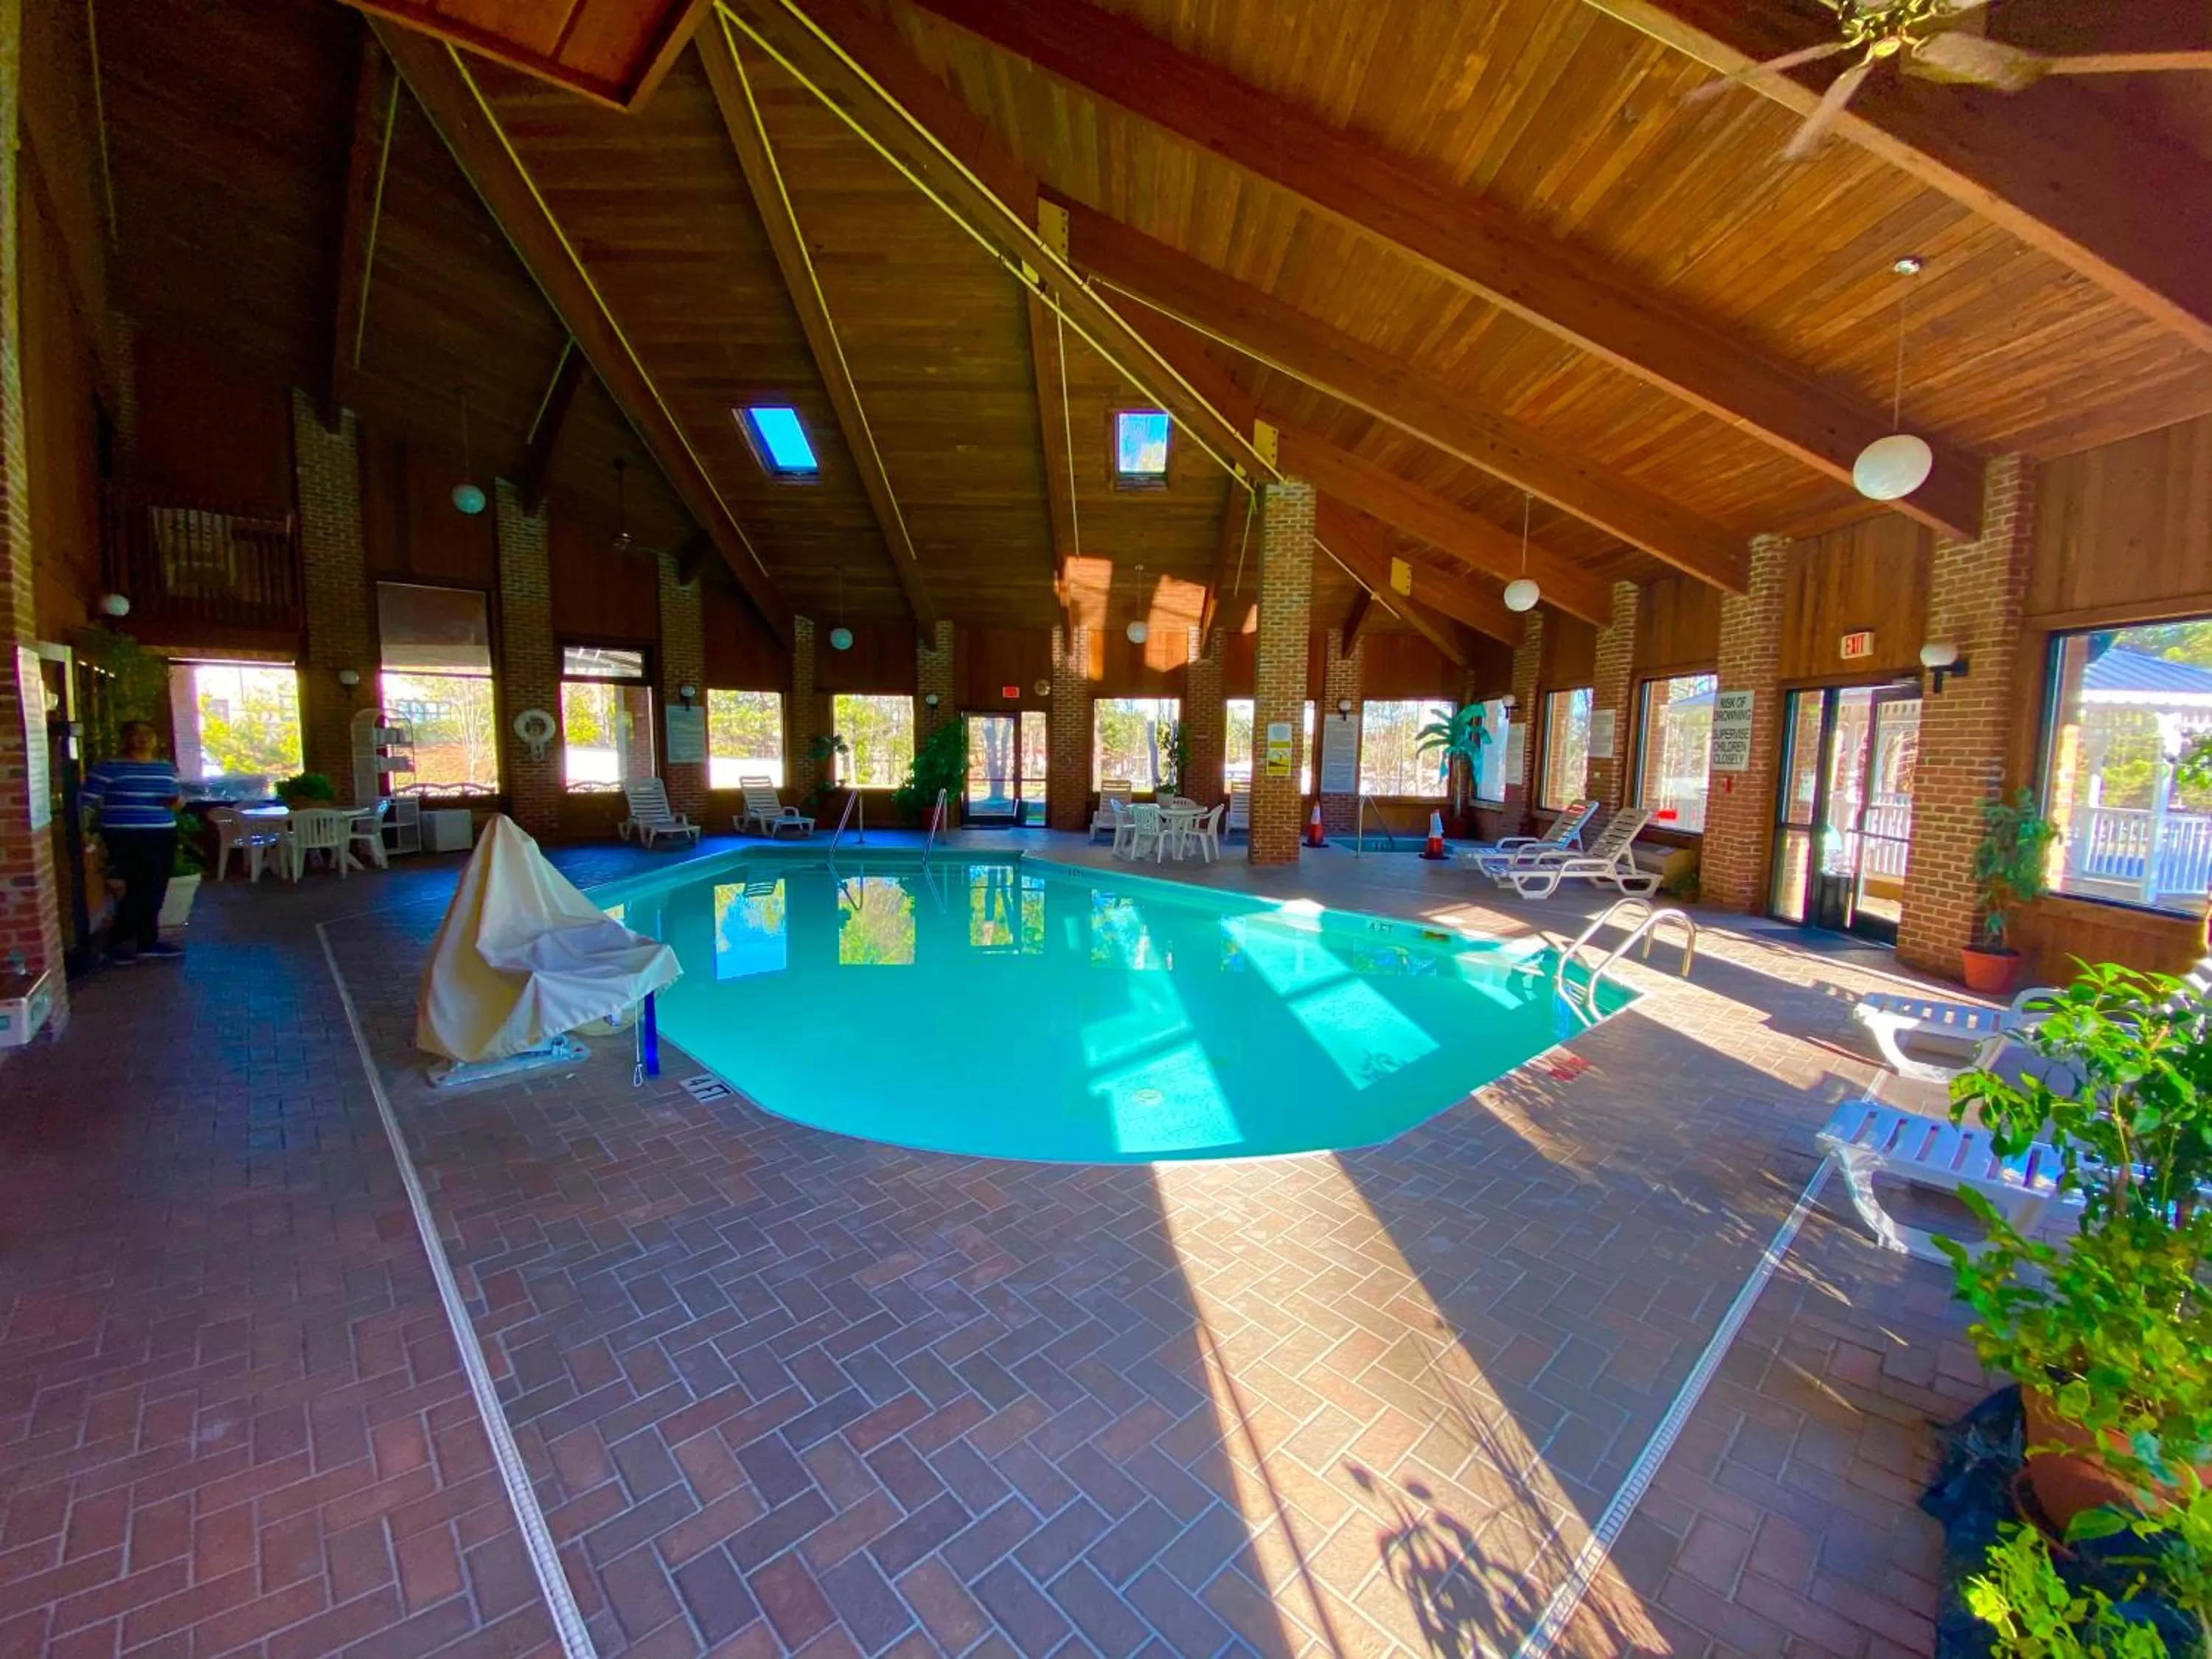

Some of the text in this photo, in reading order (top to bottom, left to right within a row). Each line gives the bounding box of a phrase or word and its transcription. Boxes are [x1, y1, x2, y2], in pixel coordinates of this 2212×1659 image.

[1846, 635, 1864, 655] EXIT
[1736, 696, 1747, 708] OF
[1714, 709, 1751, 721] DROWNING
[1712, 728, 1749, 740] SUPERVISE
[1713, 741, 1746, 752] CHILDREN
[1714, 754, 1744, 764] CLOSELY
[693, 1084, 731, 1099] FT
